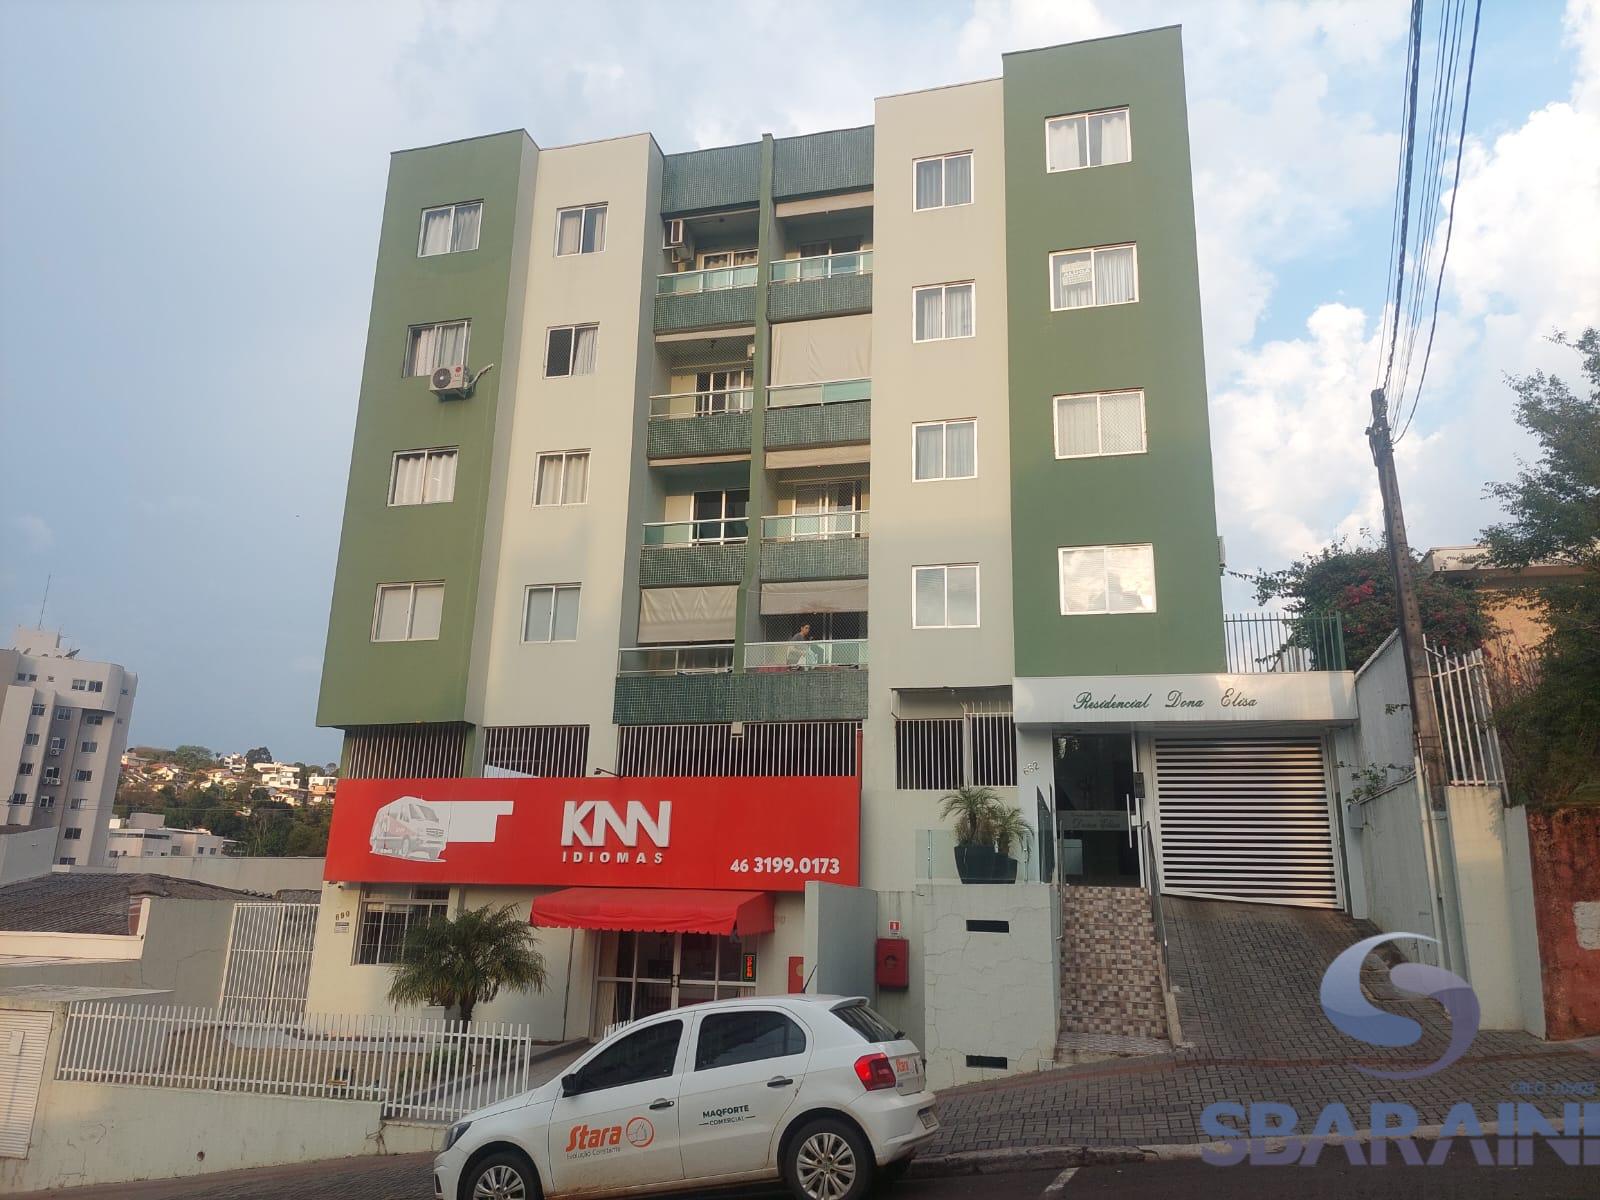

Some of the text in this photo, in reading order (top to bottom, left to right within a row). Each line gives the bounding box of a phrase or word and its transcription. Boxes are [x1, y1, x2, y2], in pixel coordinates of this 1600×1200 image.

[1073, 687, 1258, 709] Residencial Dona Elisa
[561, 800, 672, 847] KNN
[562, 851, 664, 863] IDIOMAS
[730, 856, 840, 875] 46 3199.0173
[702, 1104, 750, 1119] MAQFORTE
[565, 1124, 622, 1152] Stara
